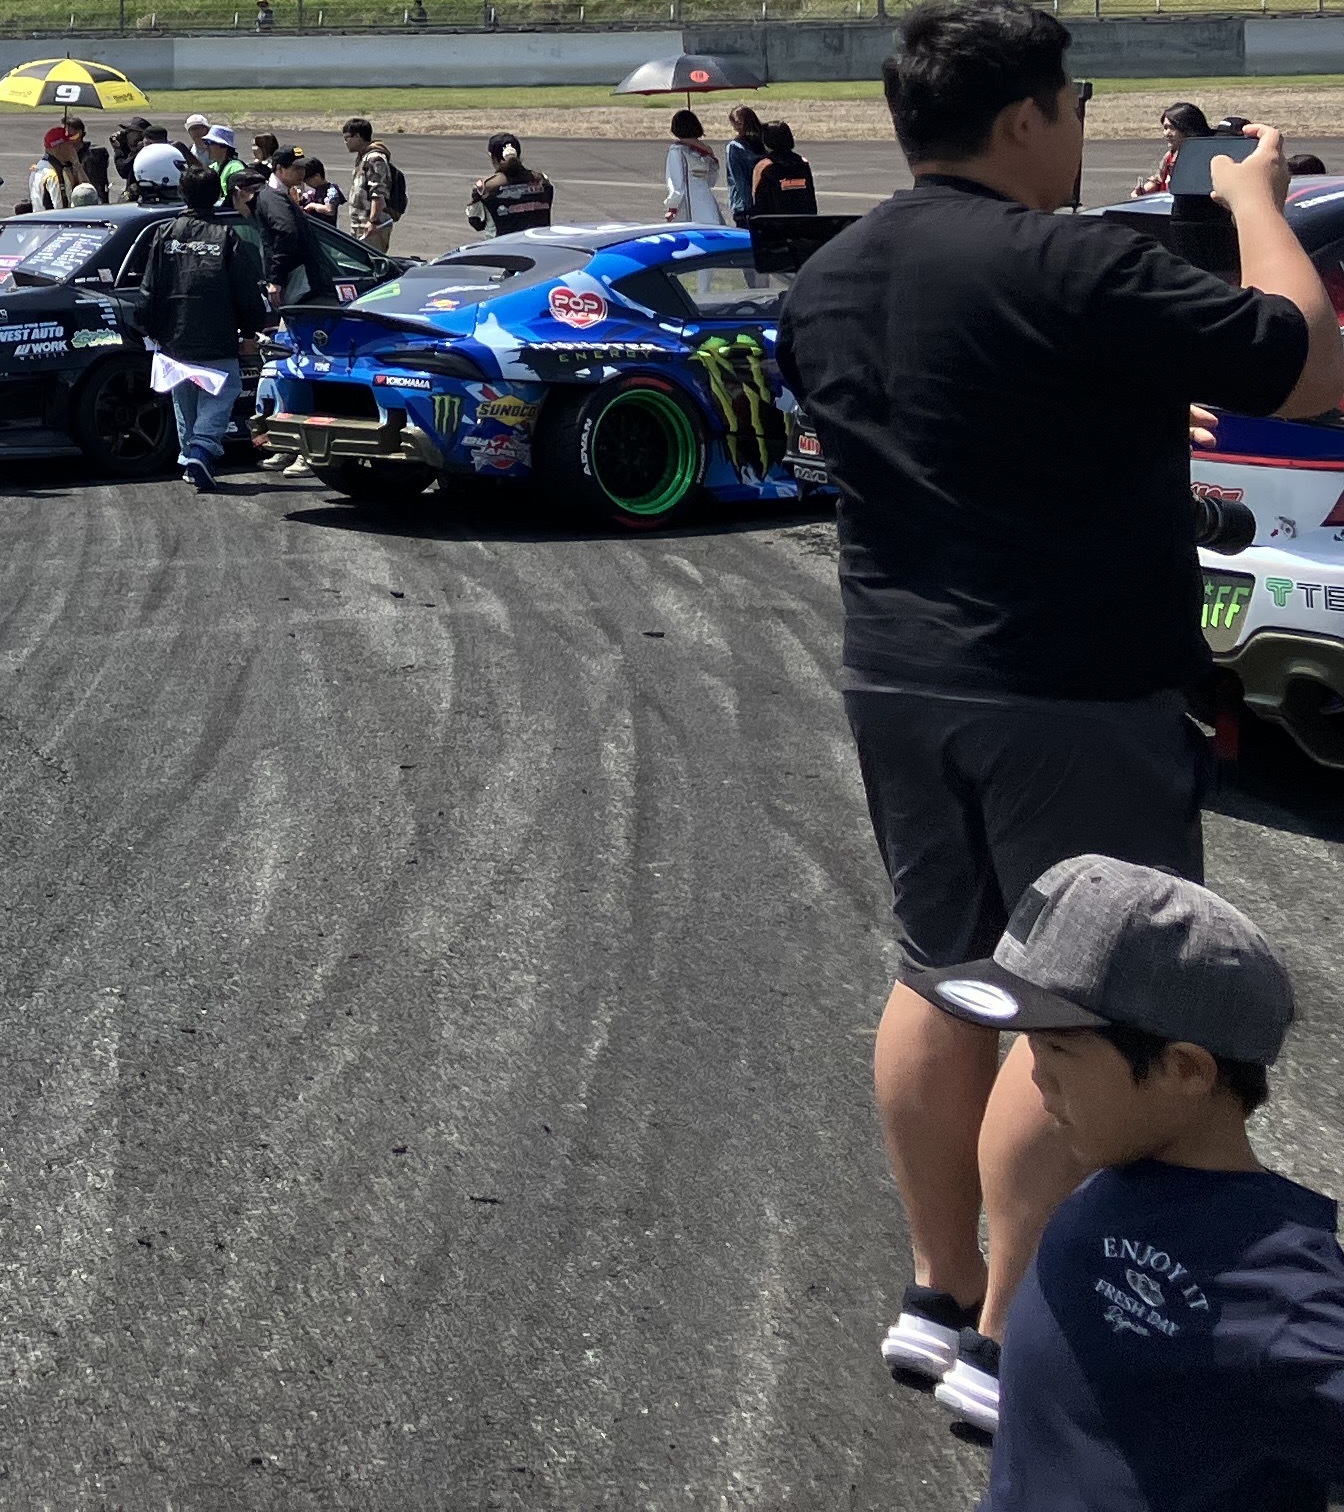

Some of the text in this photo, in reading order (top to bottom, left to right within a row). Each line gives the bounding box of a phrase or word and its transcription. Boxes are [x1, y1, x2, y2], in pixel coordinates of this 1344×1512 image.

[54, 84, 81, 103] 9
[554, 293, 599, 311] POP
[31, 326, 64, 339] AUTO
[31, 340, 69, 354] WORK
[558, 349, 651, 363] ENERGY
[385, 376, 431, 389] YOKOHAMA
[478, 402, 538, 418] SUNOCO
[1103, 1238, 1188, 1283] ENJOY
[1094, 1278, 1146, 1318] FRESH
